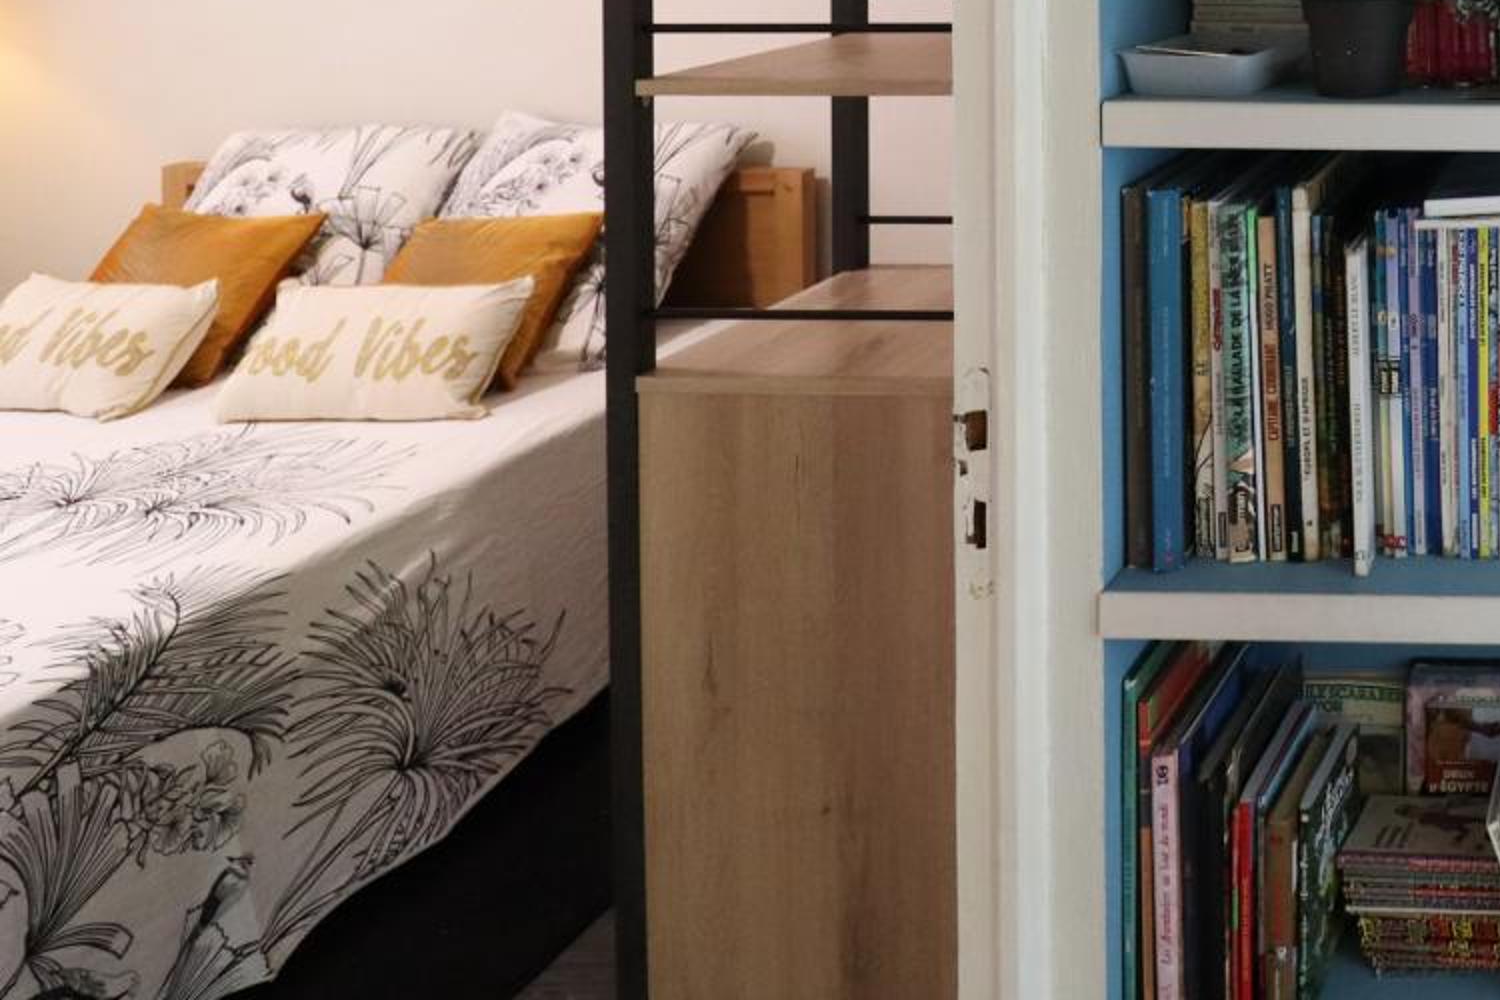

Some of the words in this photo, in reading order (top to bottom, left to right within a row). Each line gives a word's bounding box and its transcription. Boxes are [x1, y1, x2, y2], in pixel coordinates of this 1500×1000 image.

[39, 307, 156, 378] Vibes
[248, 318, 345, 383] ood
[353, 315, 482, 382] Vibes
[1264, 304, 1274, 331] HUGO
